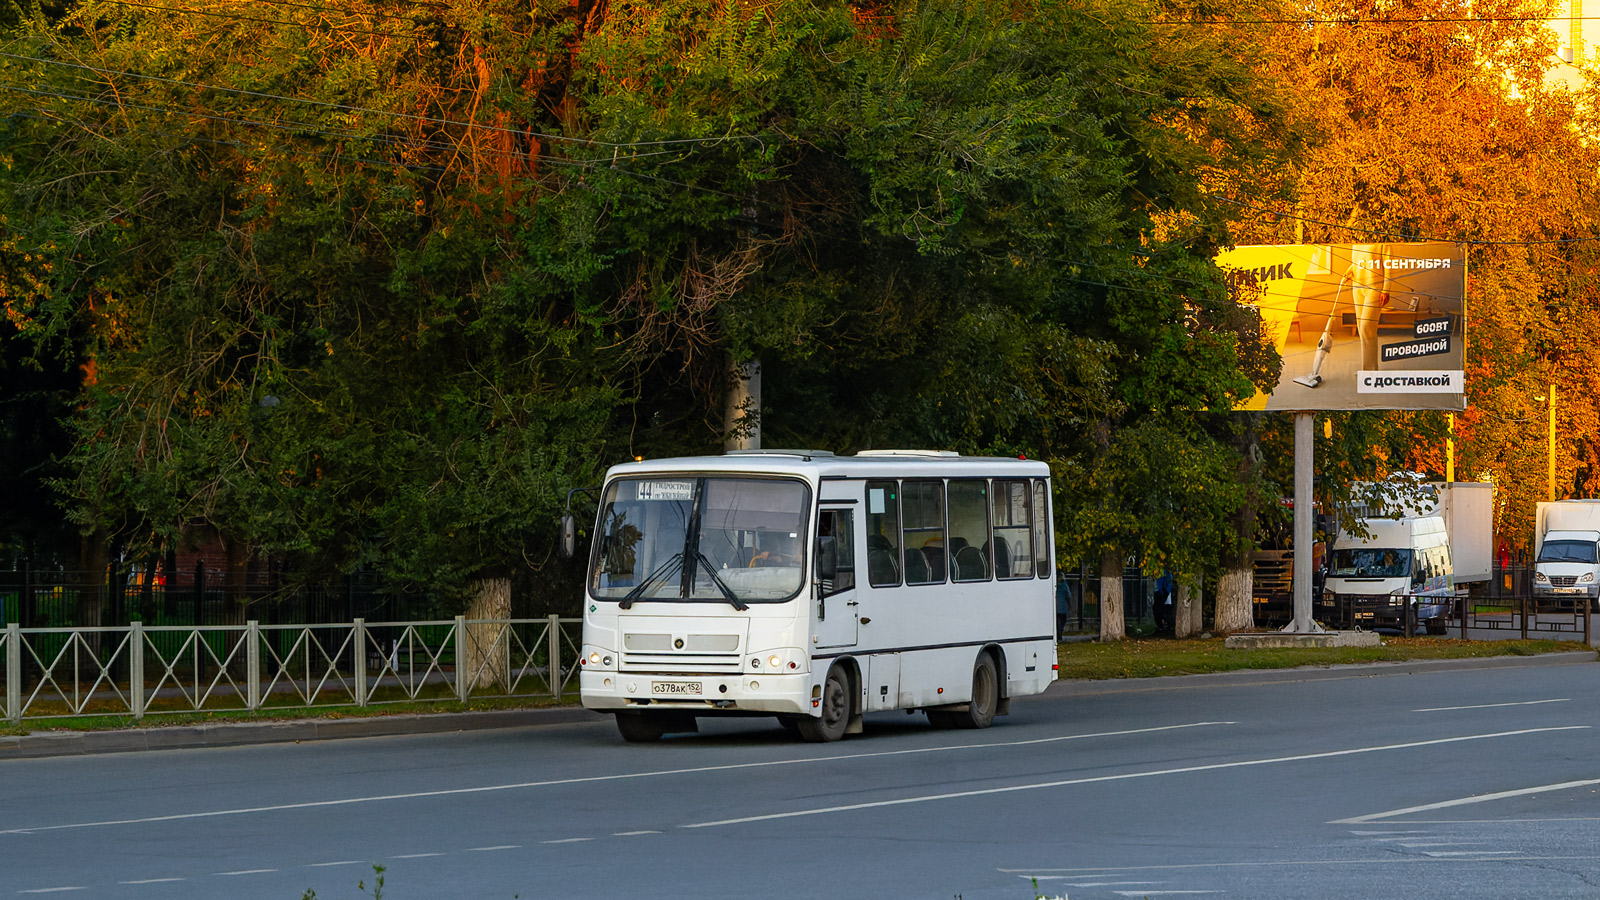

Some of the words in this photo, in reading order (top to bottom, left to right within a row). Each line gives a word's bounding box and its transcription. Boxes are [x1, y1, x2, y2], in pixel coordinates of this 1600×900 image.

[1368, 259, 1380, 269] 11
[1383, 258, 1451, 269] СЕНТЯБРЯ
[1416, 321, 1449, 335] 600ВТ
[1385, 339, 1448, 358] ПРОВОДНОЙ
[1364, 377, 1372, 387] С
[1374, 375, 1450, 388] ДОСТАВКОЙ
[640, 481, 652, 500] 44
